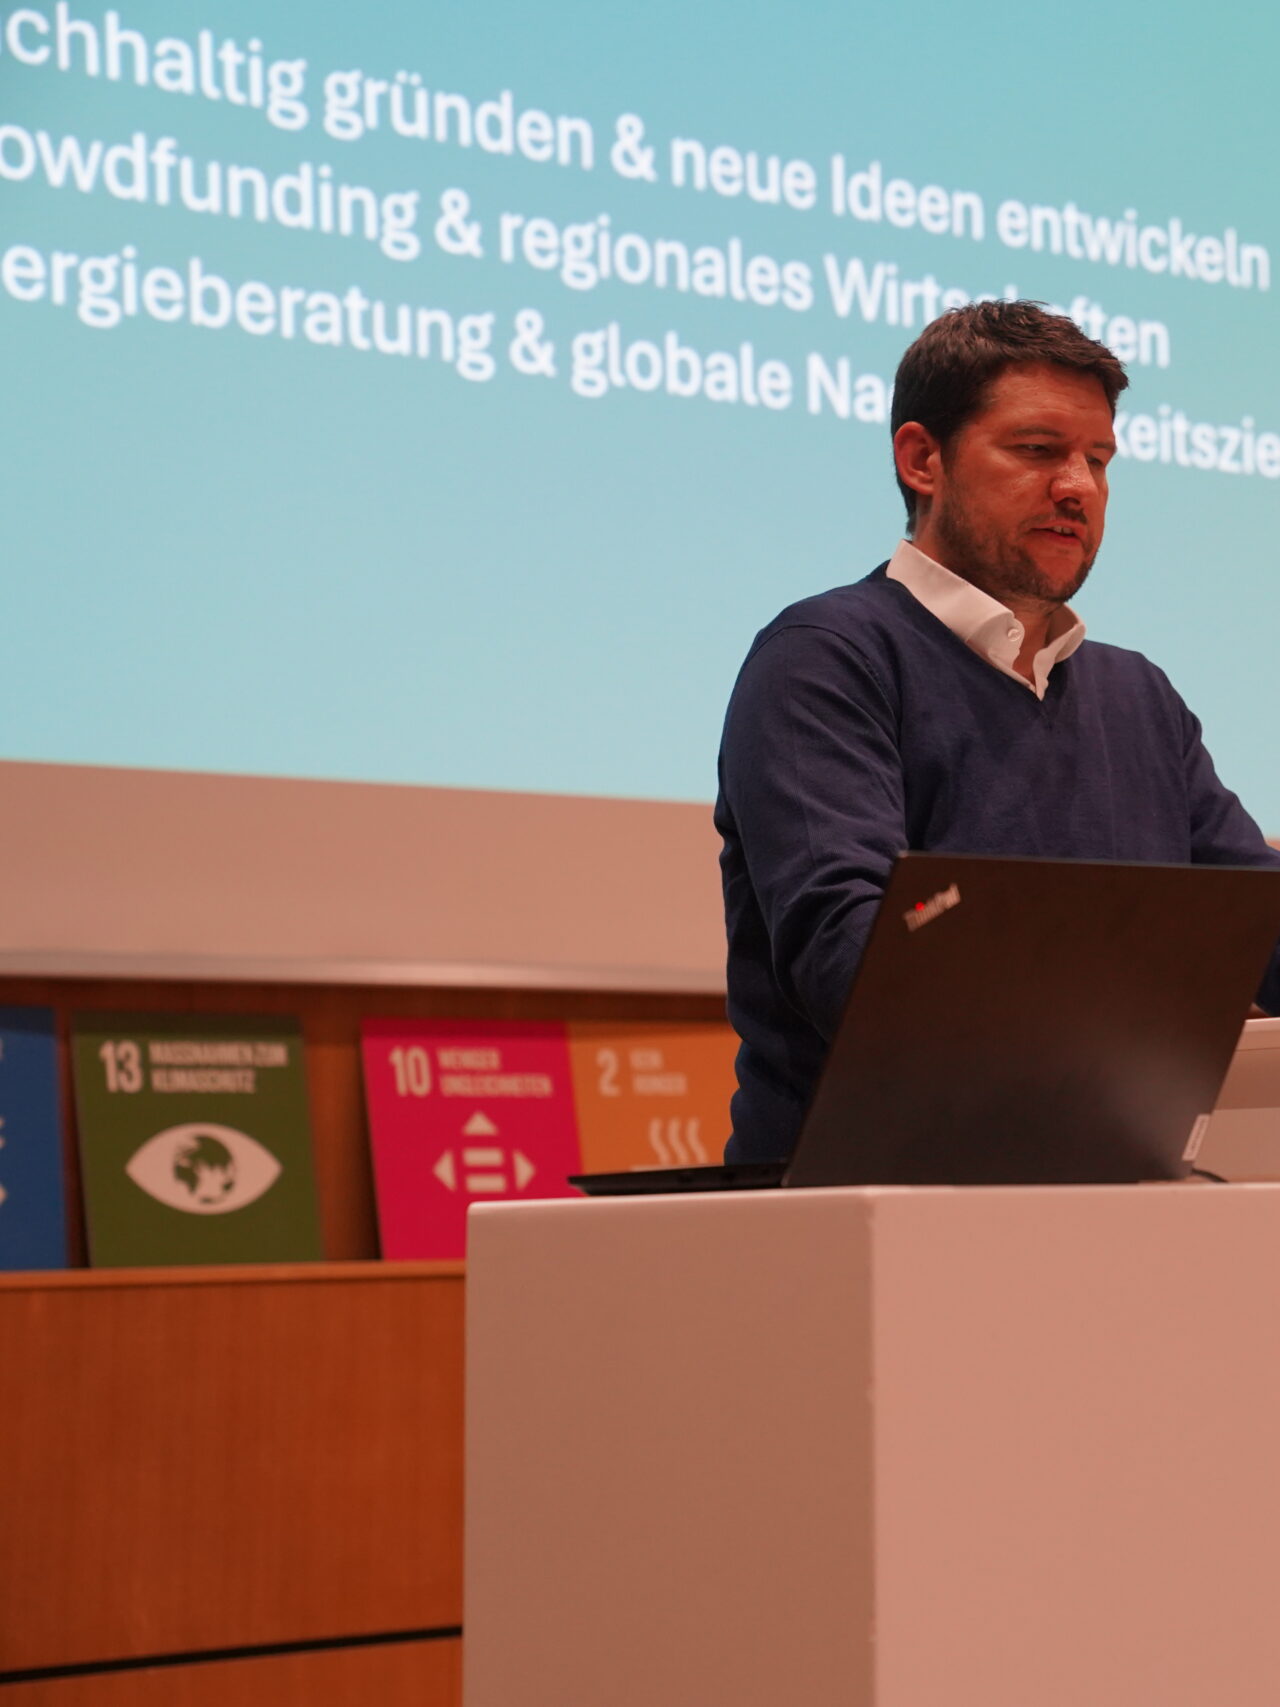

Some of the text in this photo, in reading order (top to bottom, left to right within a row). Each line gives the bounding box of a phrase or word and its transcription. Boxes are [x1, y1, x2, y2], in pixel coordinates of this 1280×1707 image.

[0, 124, 420, 261] owdfunding
[435, 188, 483, 259] &
[501, 213, 814, 311] regionales
[324, 69, 594, 171] gründen
[611, 113, 657, 182] &
[671, 137, 817, 210] neue
[832, 153, 985, 241] Ideen
[997, 199, 1270, 291] entwickeln
[1, 245, 496, 382] ergieberatung
[509, 309, 556, 378] &
[572, 323, 794, 411] globale
[100, 1039, 142, 1093] 13
[389, 1047, 431, 1097] 10
[597, 1048, 620, 1097] 2
